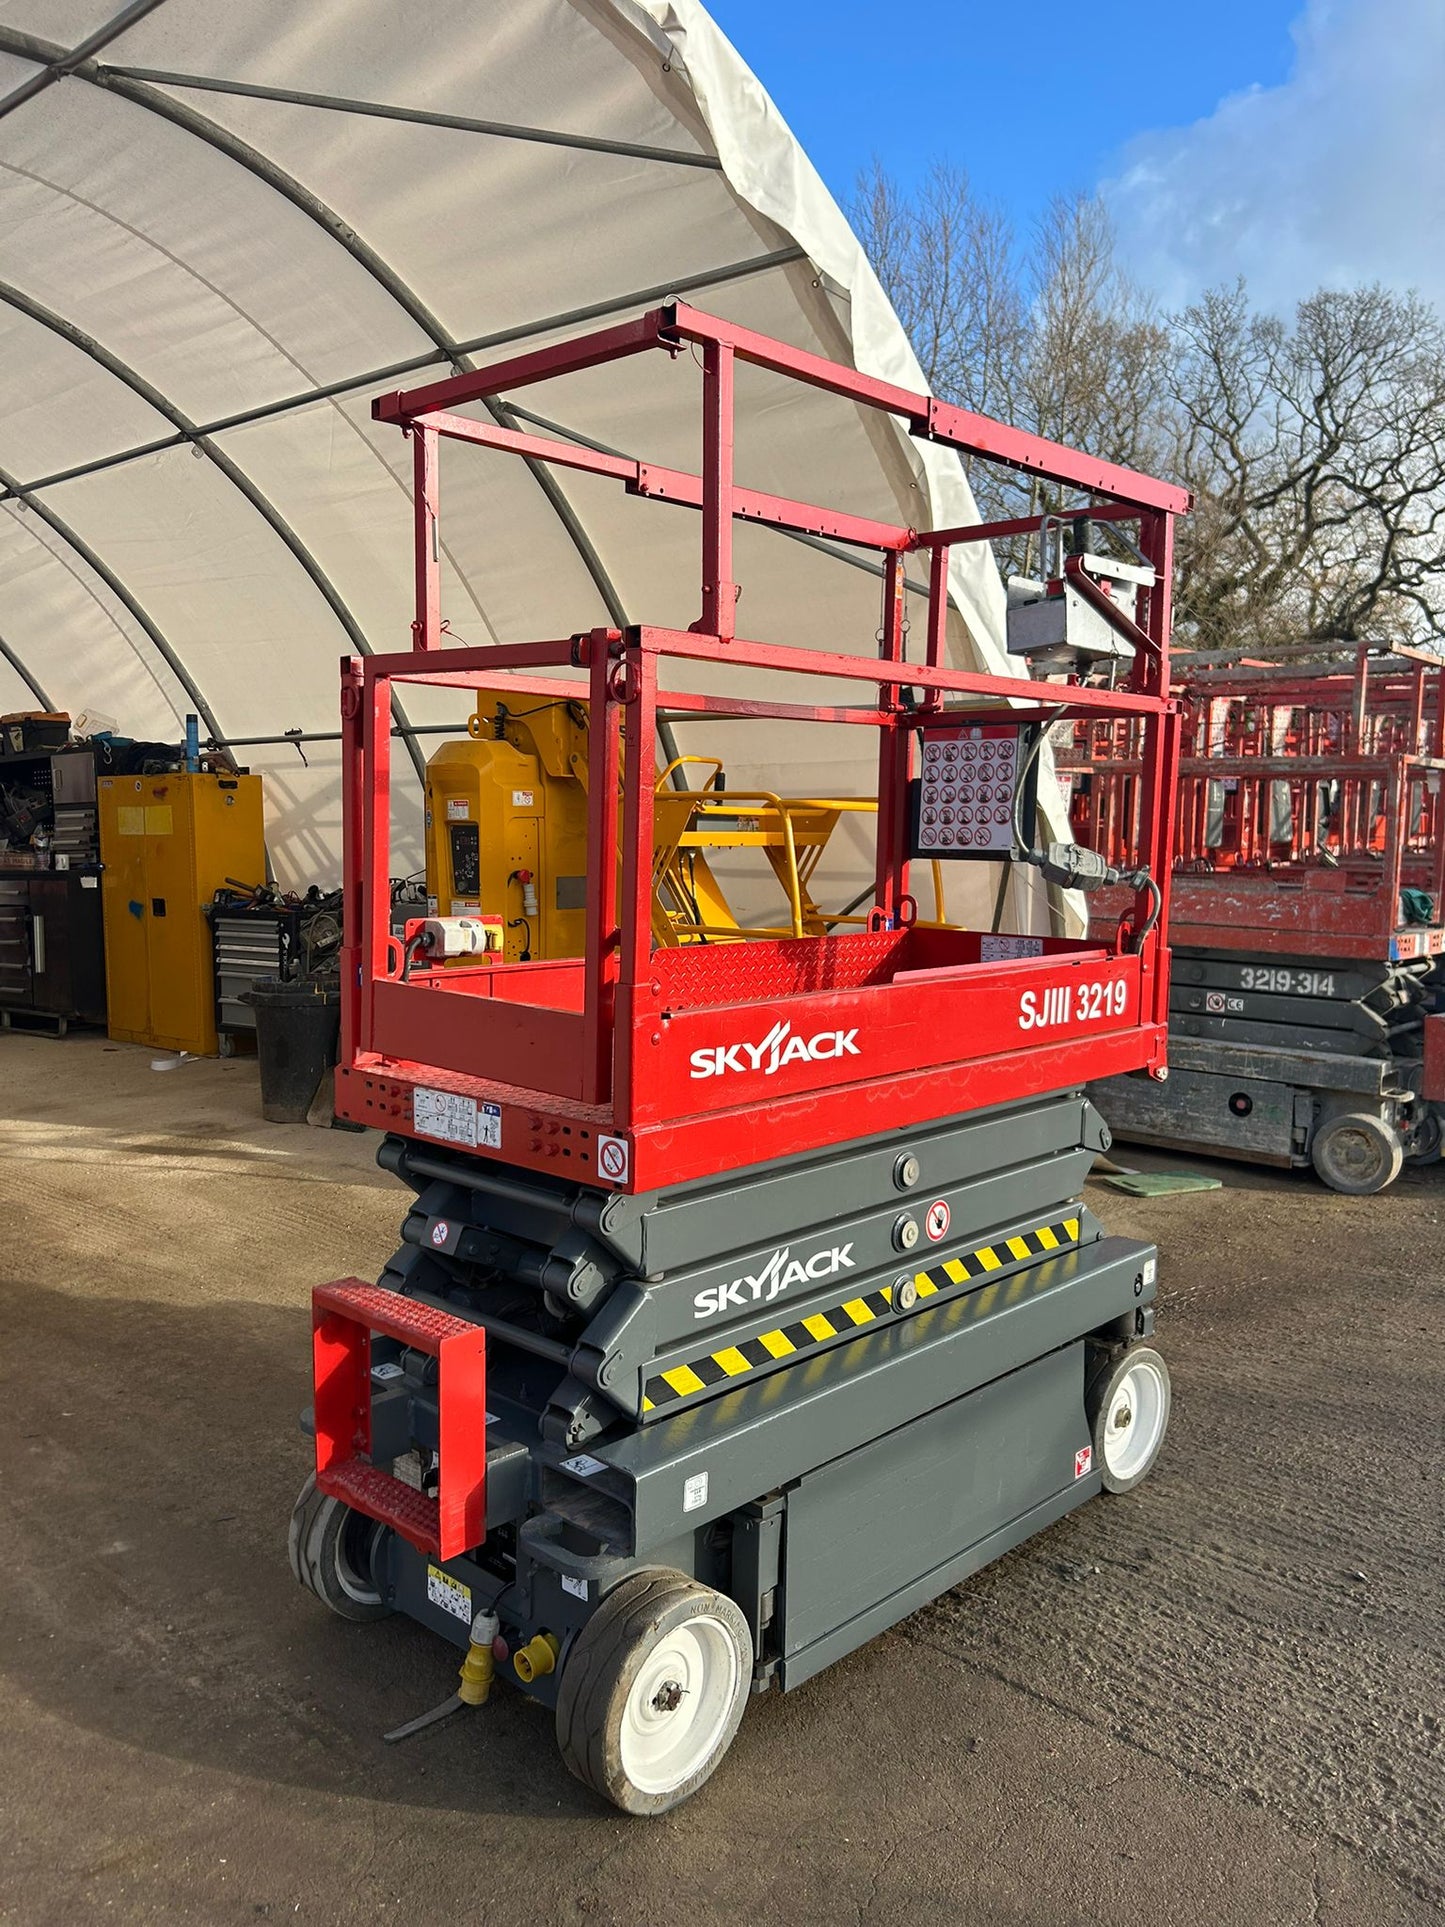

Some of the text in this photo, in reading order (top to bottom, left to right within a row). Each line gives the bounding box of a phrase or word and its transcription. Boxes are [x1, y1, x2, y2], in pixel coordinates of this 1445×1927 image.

[1018, 979, 1127, 1030] SJIII 3219
[1240, 967, 1335, 996] 3219-314
[690, 1019, 862, 1079] SKYJACK
[693, 1247, 857, 1319] SKYJACK
